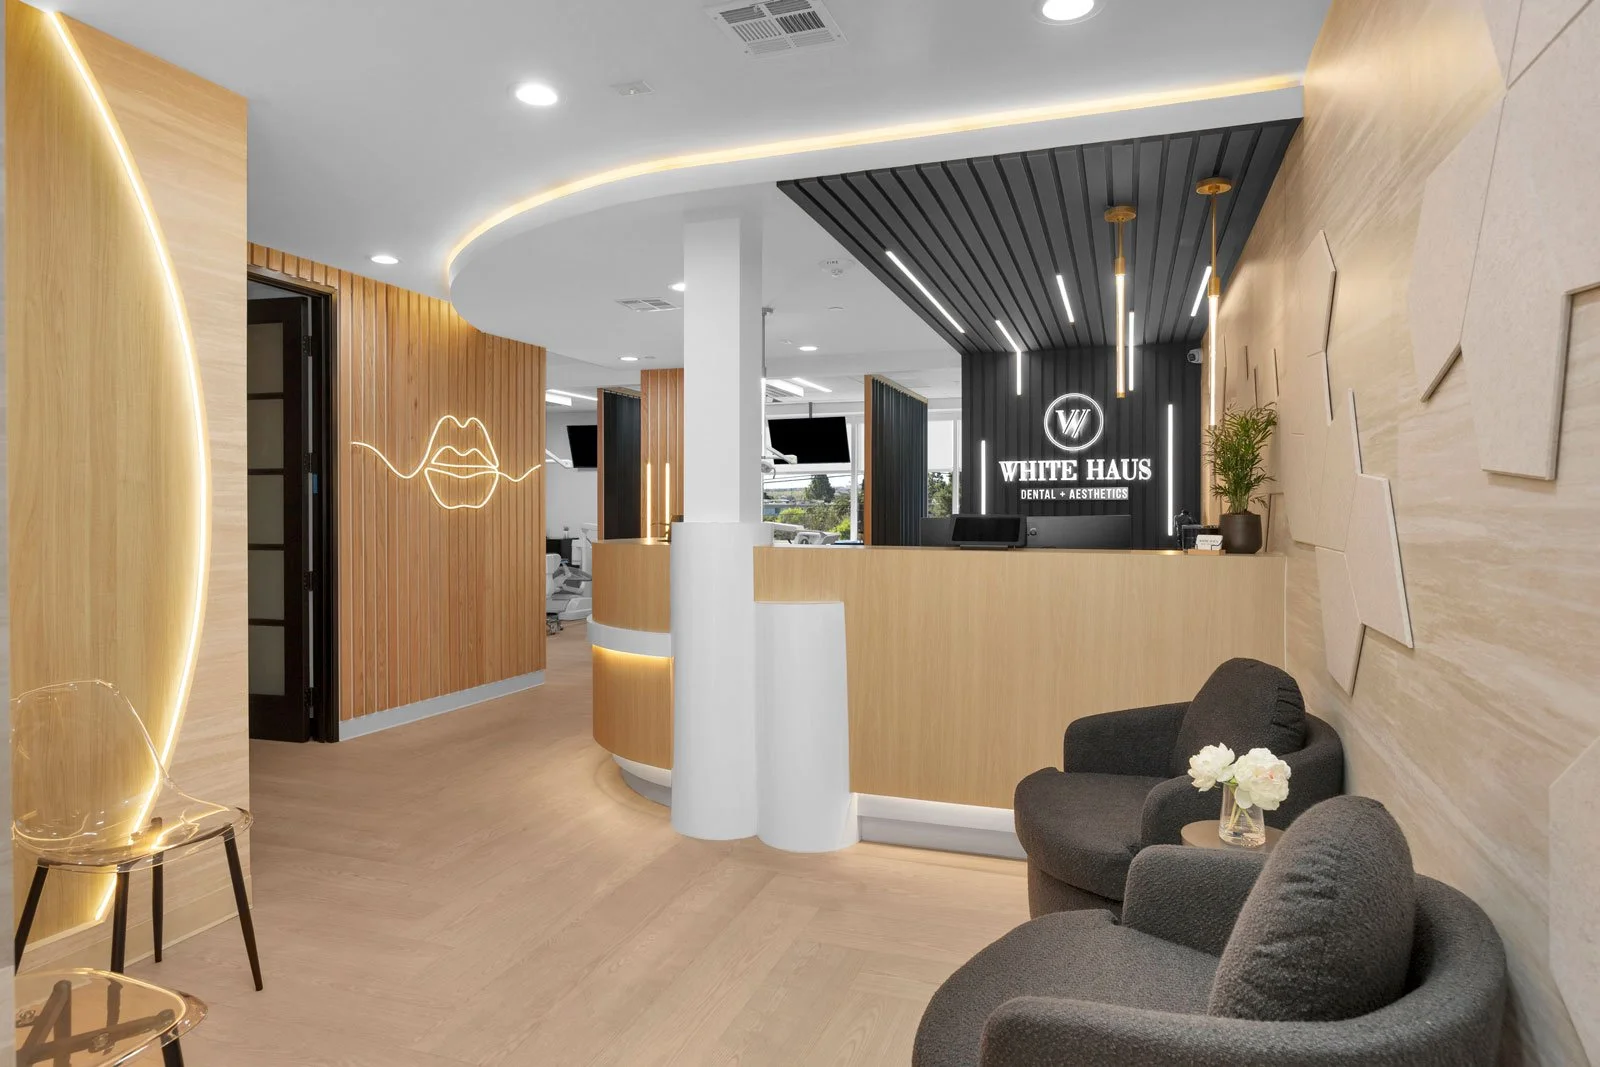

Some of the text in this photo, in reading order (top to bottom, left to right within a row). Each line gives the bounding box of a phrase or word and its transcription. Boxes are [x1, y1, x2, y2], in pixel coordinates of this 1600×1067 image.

[999, 458, 1152, 482] WHITE HAUS
[1020, 489, 1056, 500] DENTAL
[1069, 488, 1128, 500] AESTHETICS
